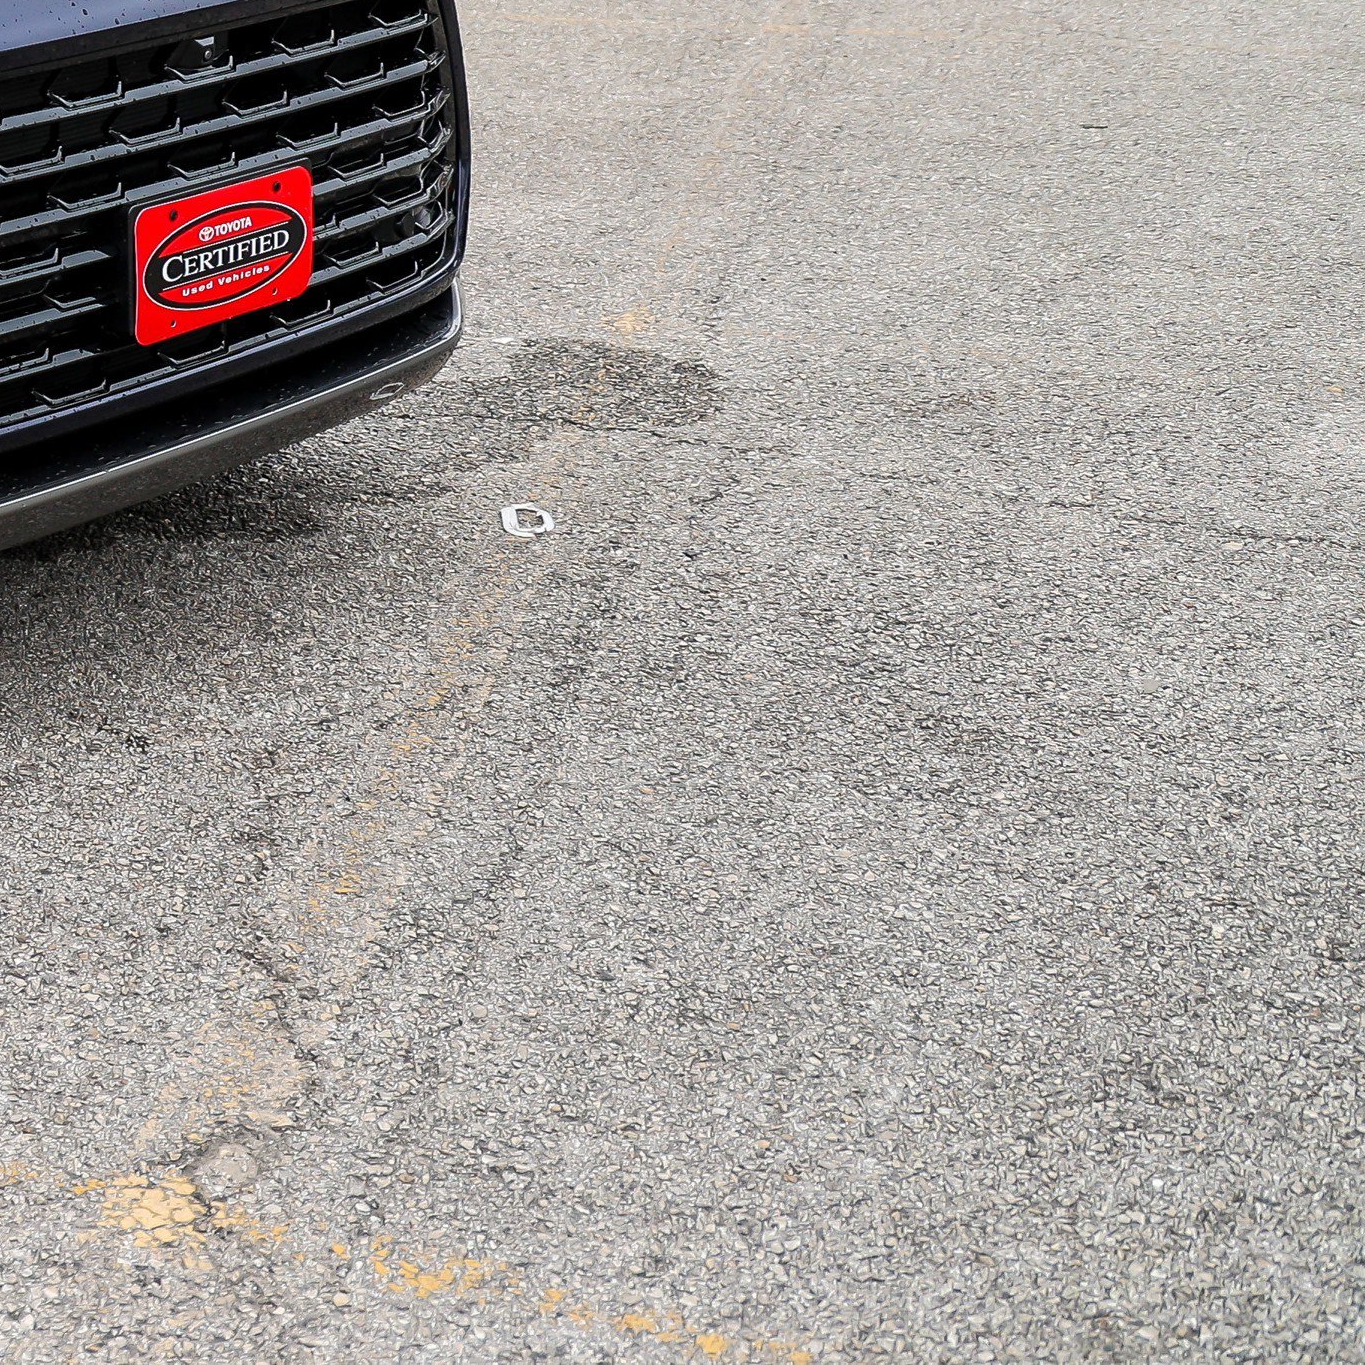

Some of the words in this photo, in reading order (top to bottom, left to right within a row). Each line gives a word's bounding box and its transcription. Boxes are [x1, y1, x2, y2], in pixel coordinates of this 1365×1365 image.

[215, 217, 252, 236] TOYOTA
[162, 230, 290, 283] CERTIFIED
[182, 280, 214, 297] Used
[218, 265, 270, 286] Vehicles
